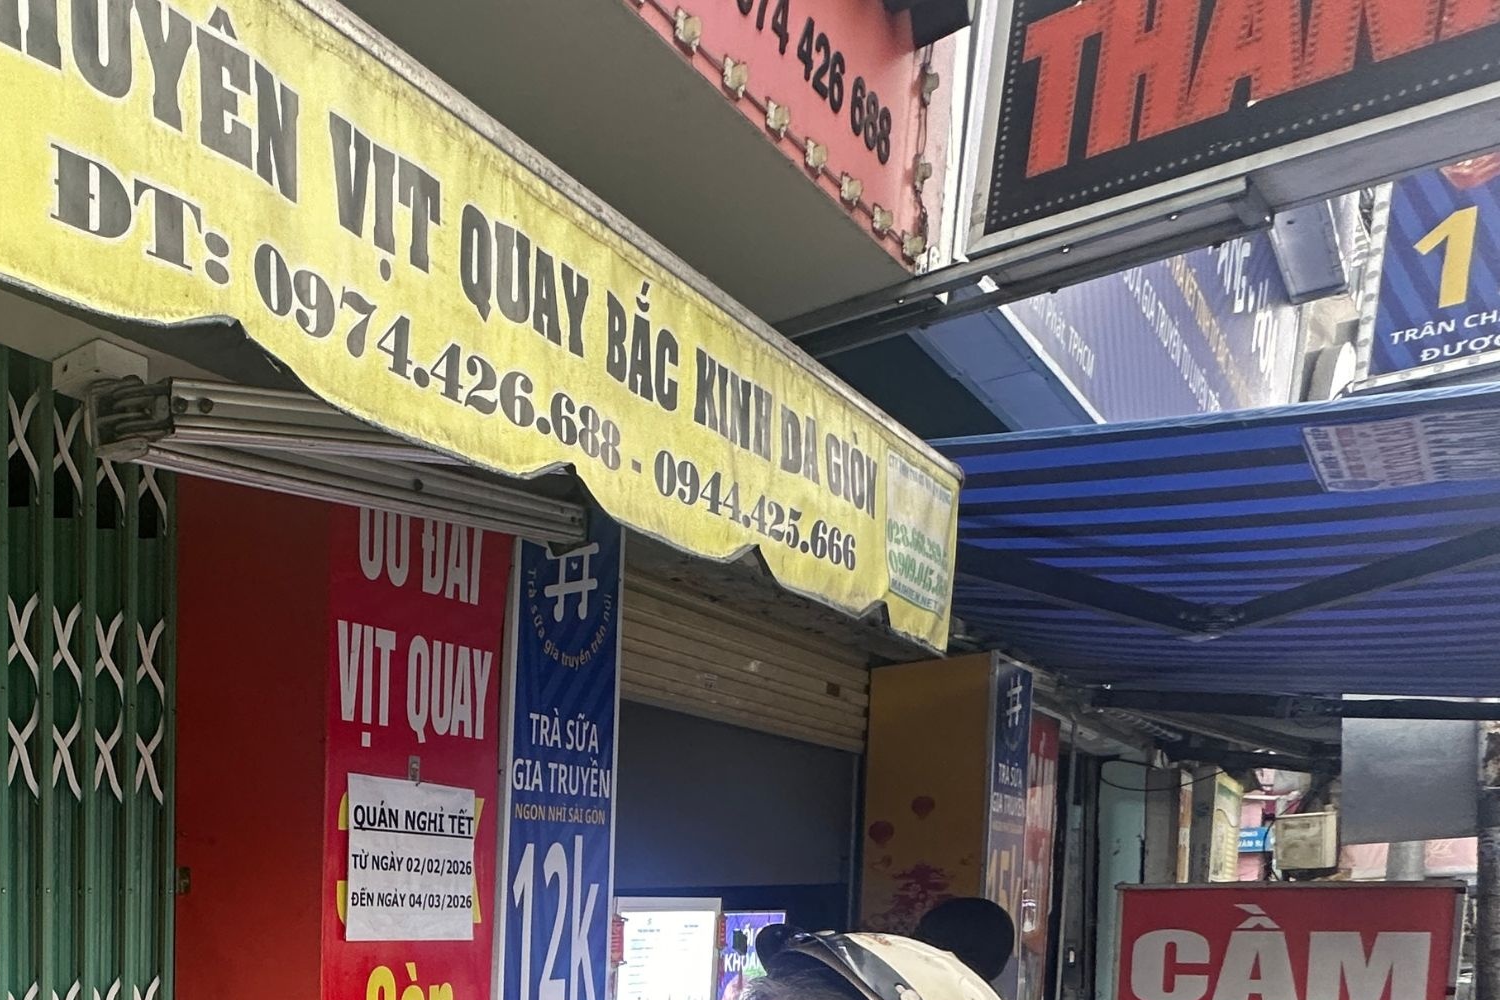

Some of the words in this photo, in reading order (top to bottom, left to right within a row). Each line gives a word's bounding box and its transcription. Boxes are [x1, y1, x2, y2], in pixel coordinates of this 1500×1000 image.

[798, 17, 845, 113] 426
[851, 76, 891, 164] 688
[330, 111, 441, 282] VỊT
[461, 204, 588, 358] QUAY
[606, 281, 679, 411] BẮC
[694, 347, 772, 462] KINH
[781, 404, 820, 485] DA
[826, 431, 877, 520] GIÒN
[1390, 319, 1455, 344] TRÂN
[1464, 309, 1500, 328] CH
[50, 143, 230, 285] ĐT:
[255, 244, 621, 472] 0974.426.688
[654, 450, 856, 571] 0944.425.666
[337, 620, 396, 747] VỊT
[406, 635, 493, 743] QUAY
[529, 707, 562, 749] TRÀ
[565, 712, 599, 754] SỮA
[512, 758, 543, 793] GIA
[547, 757, 611, 799] TRUYỀN
[354, 801, 399, 830] QUÁN
[404, 806, 445, 832] NGHỈ
[449, 809, 474, 835] TẾT
[514, 803, 546, 821] NGON
[352, 850, 370, 870] TỪ
[372, 851, 404, 873] NGÀY
[406, 860, 472, 876] 02/02/2026
[351, 887, 375, 907] ĐẾN
[377, 889, 407, 908] NGÀY
[409, 893, 472, 909] 04/03/2026
